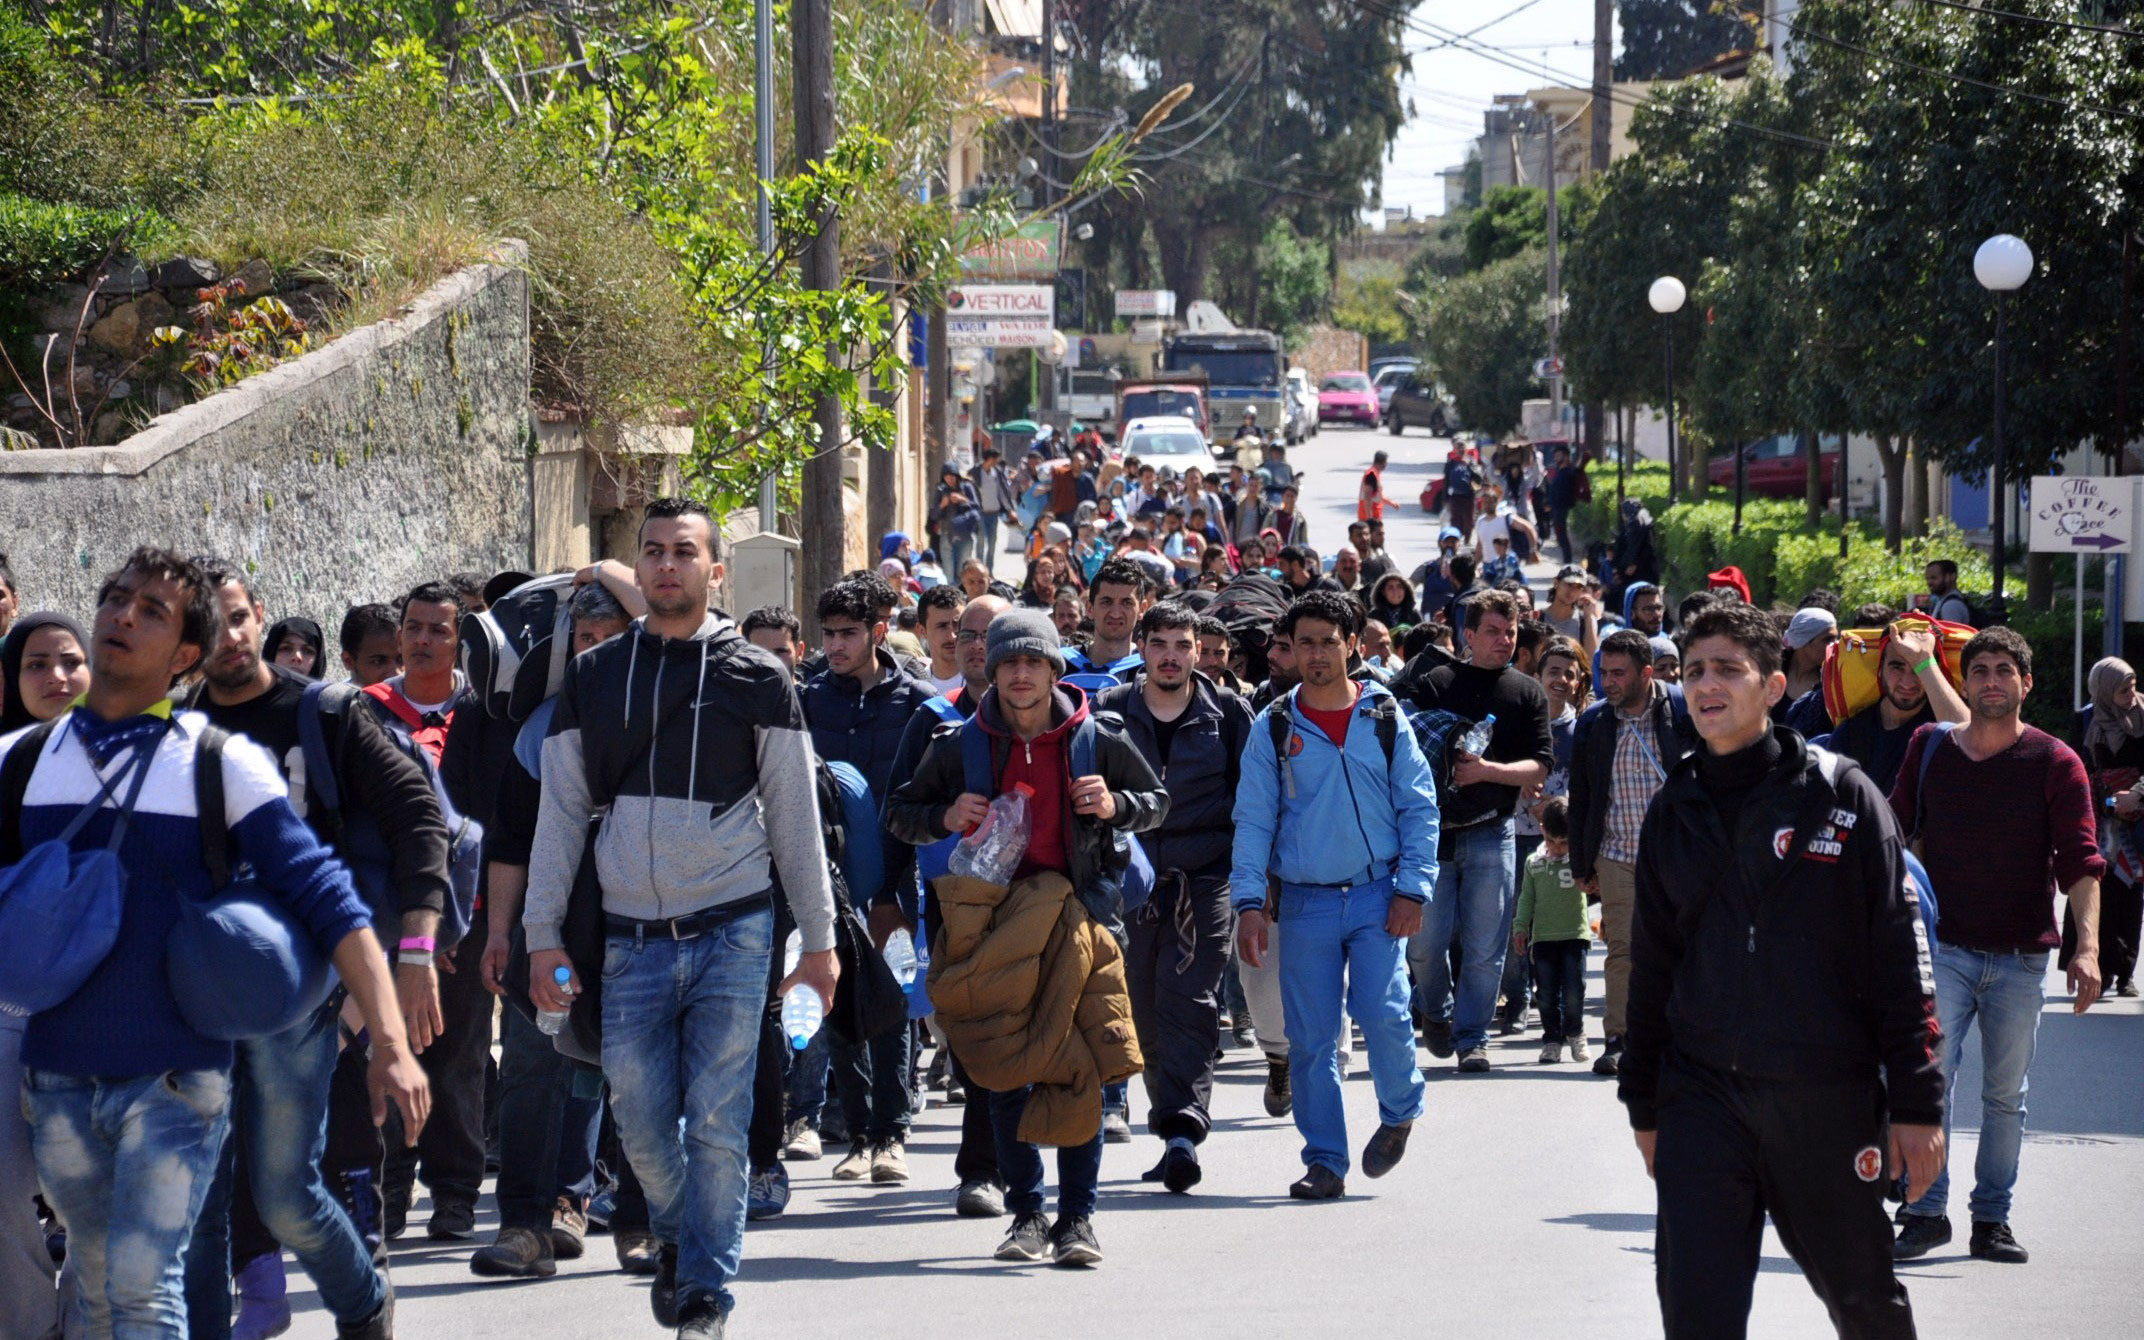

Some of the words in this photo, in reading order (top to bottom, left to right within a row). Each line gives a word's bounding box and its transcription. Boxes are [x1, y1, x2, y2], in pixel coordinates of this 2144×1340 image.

[967, 293, 1048, 310] VERTICAL
[2061, 479, 2098, 497] The
[2039, 498, 2121, 520] COFFEE
